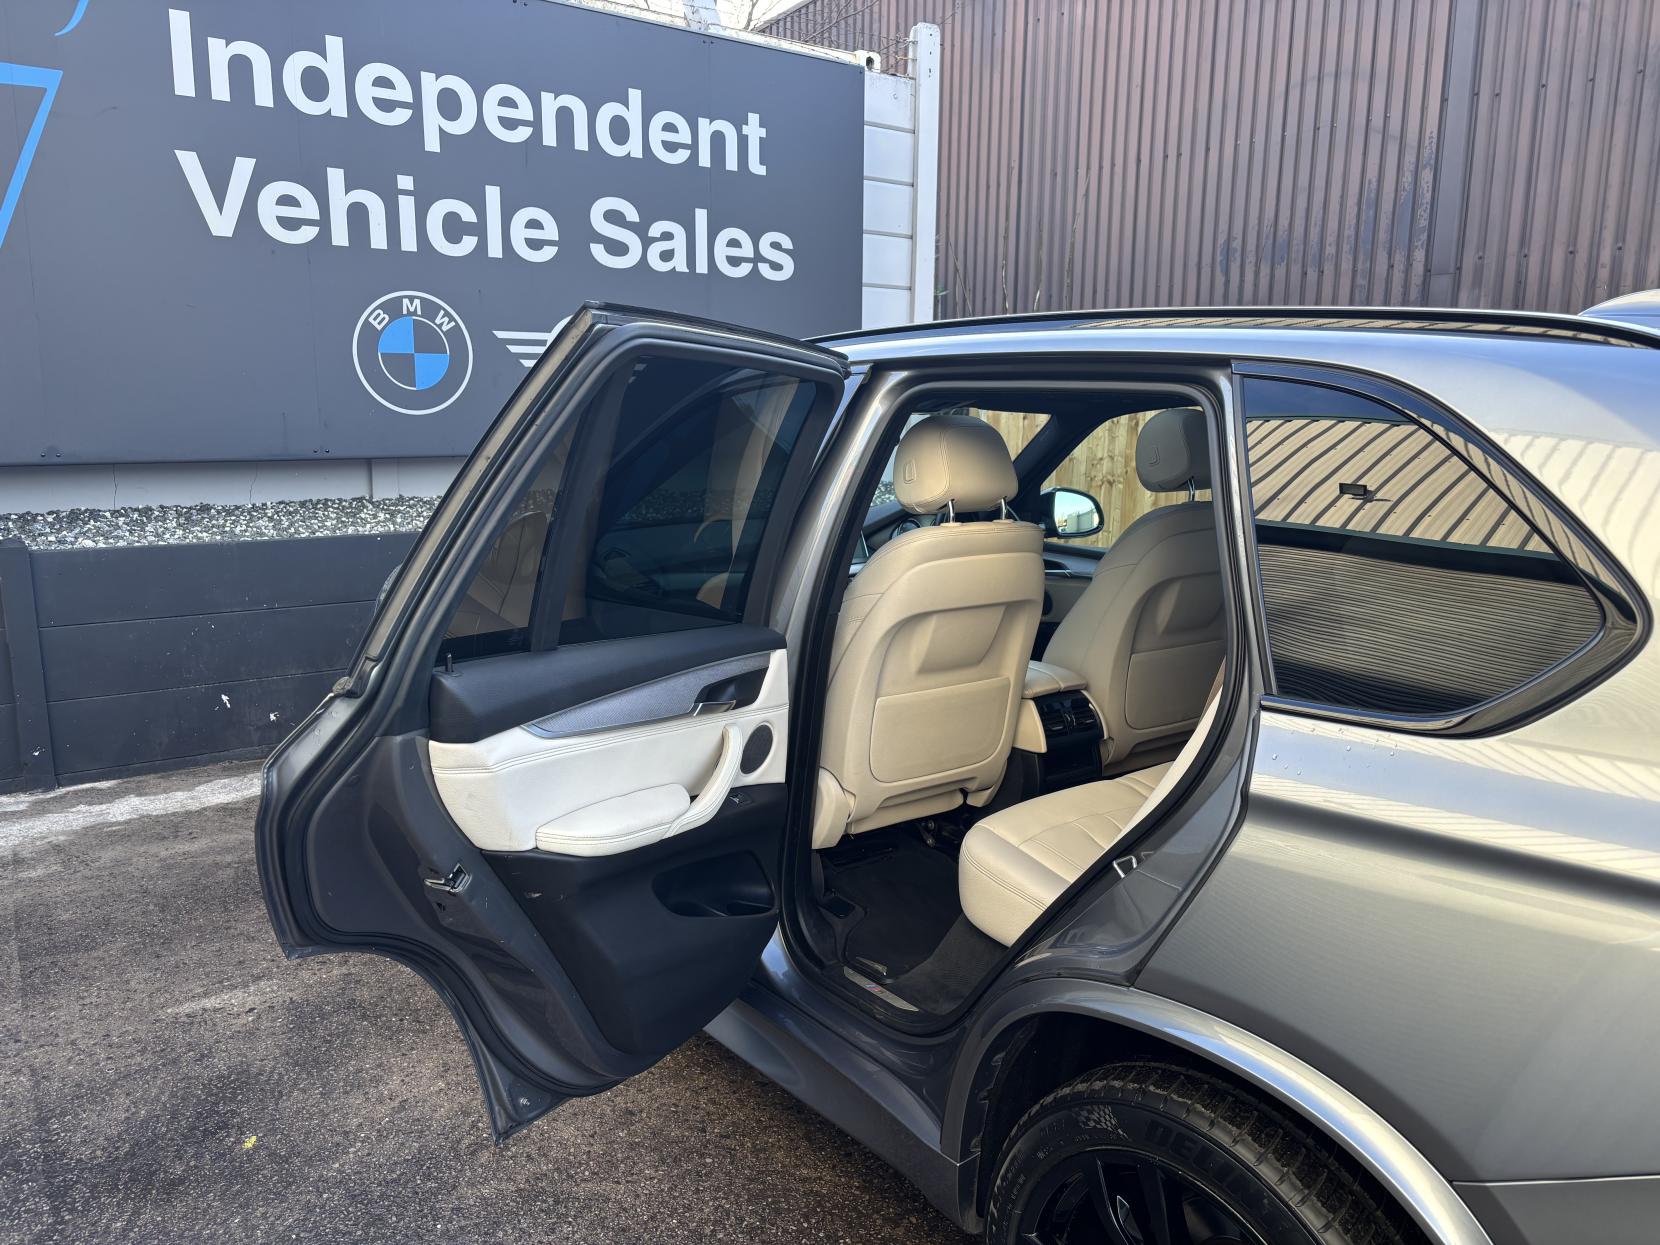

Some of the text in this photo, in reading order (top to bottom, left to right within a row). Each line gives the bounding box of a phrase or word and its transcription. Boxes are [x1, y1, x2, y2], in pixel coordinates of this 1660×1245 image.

[168, 7, 767, 176] Independent
[173, 149, 560, 263] Vehicle
[589, 196, 796, 282] Sales
[367, 297, 457, 333] BMW
